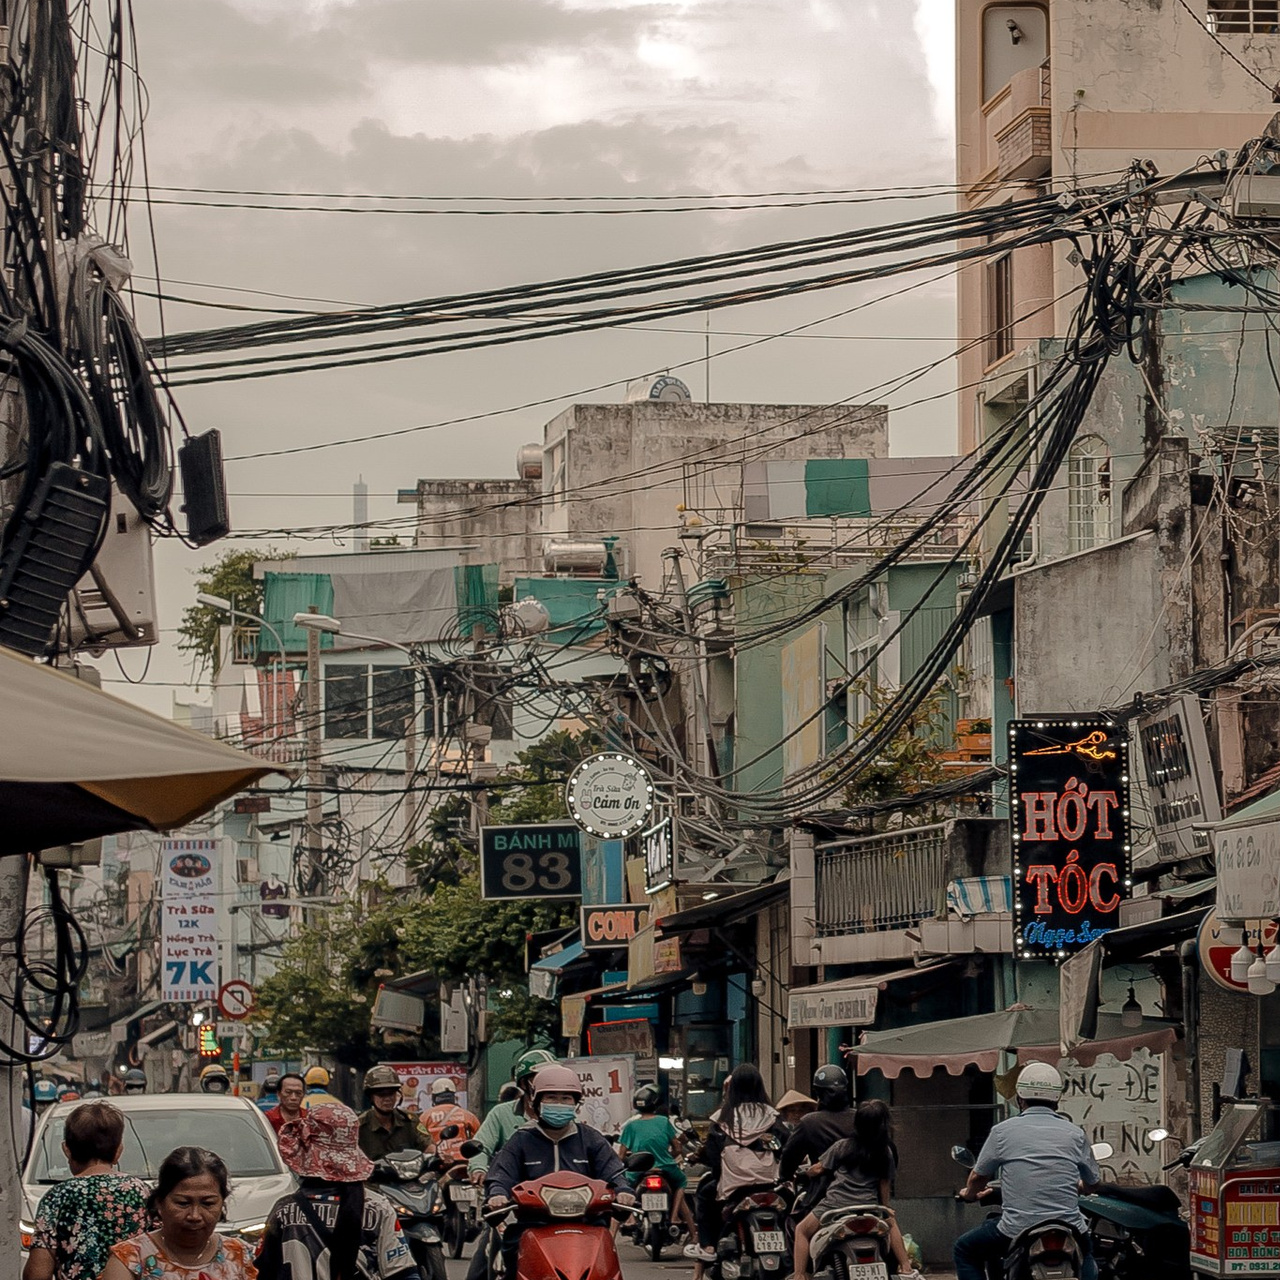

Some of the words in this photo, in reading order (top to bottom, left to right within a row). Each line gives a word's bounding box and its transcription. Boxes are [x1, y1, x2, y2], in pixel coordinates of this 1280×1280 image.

[1072, 253, 1079, 263] 6
[1021, 776, 1119, 841] HỚT
[495, 831, 551, 851] BÁNH
[502, 852, 572, 891] 83
[1025, 849, 1120, 914] TÓC
[167, 904, 187, 915] Trà
[178, 920, 200, 929] 12K
[166, 961, 214, 985] 7K
[578, 1073, 594, 1083] UA
[1254, 1228, 1269, 1243] SỐ
[1228, 1246, 1249, 1258] HOA
[1252, 1243, 1280, 1258] HỒNG
